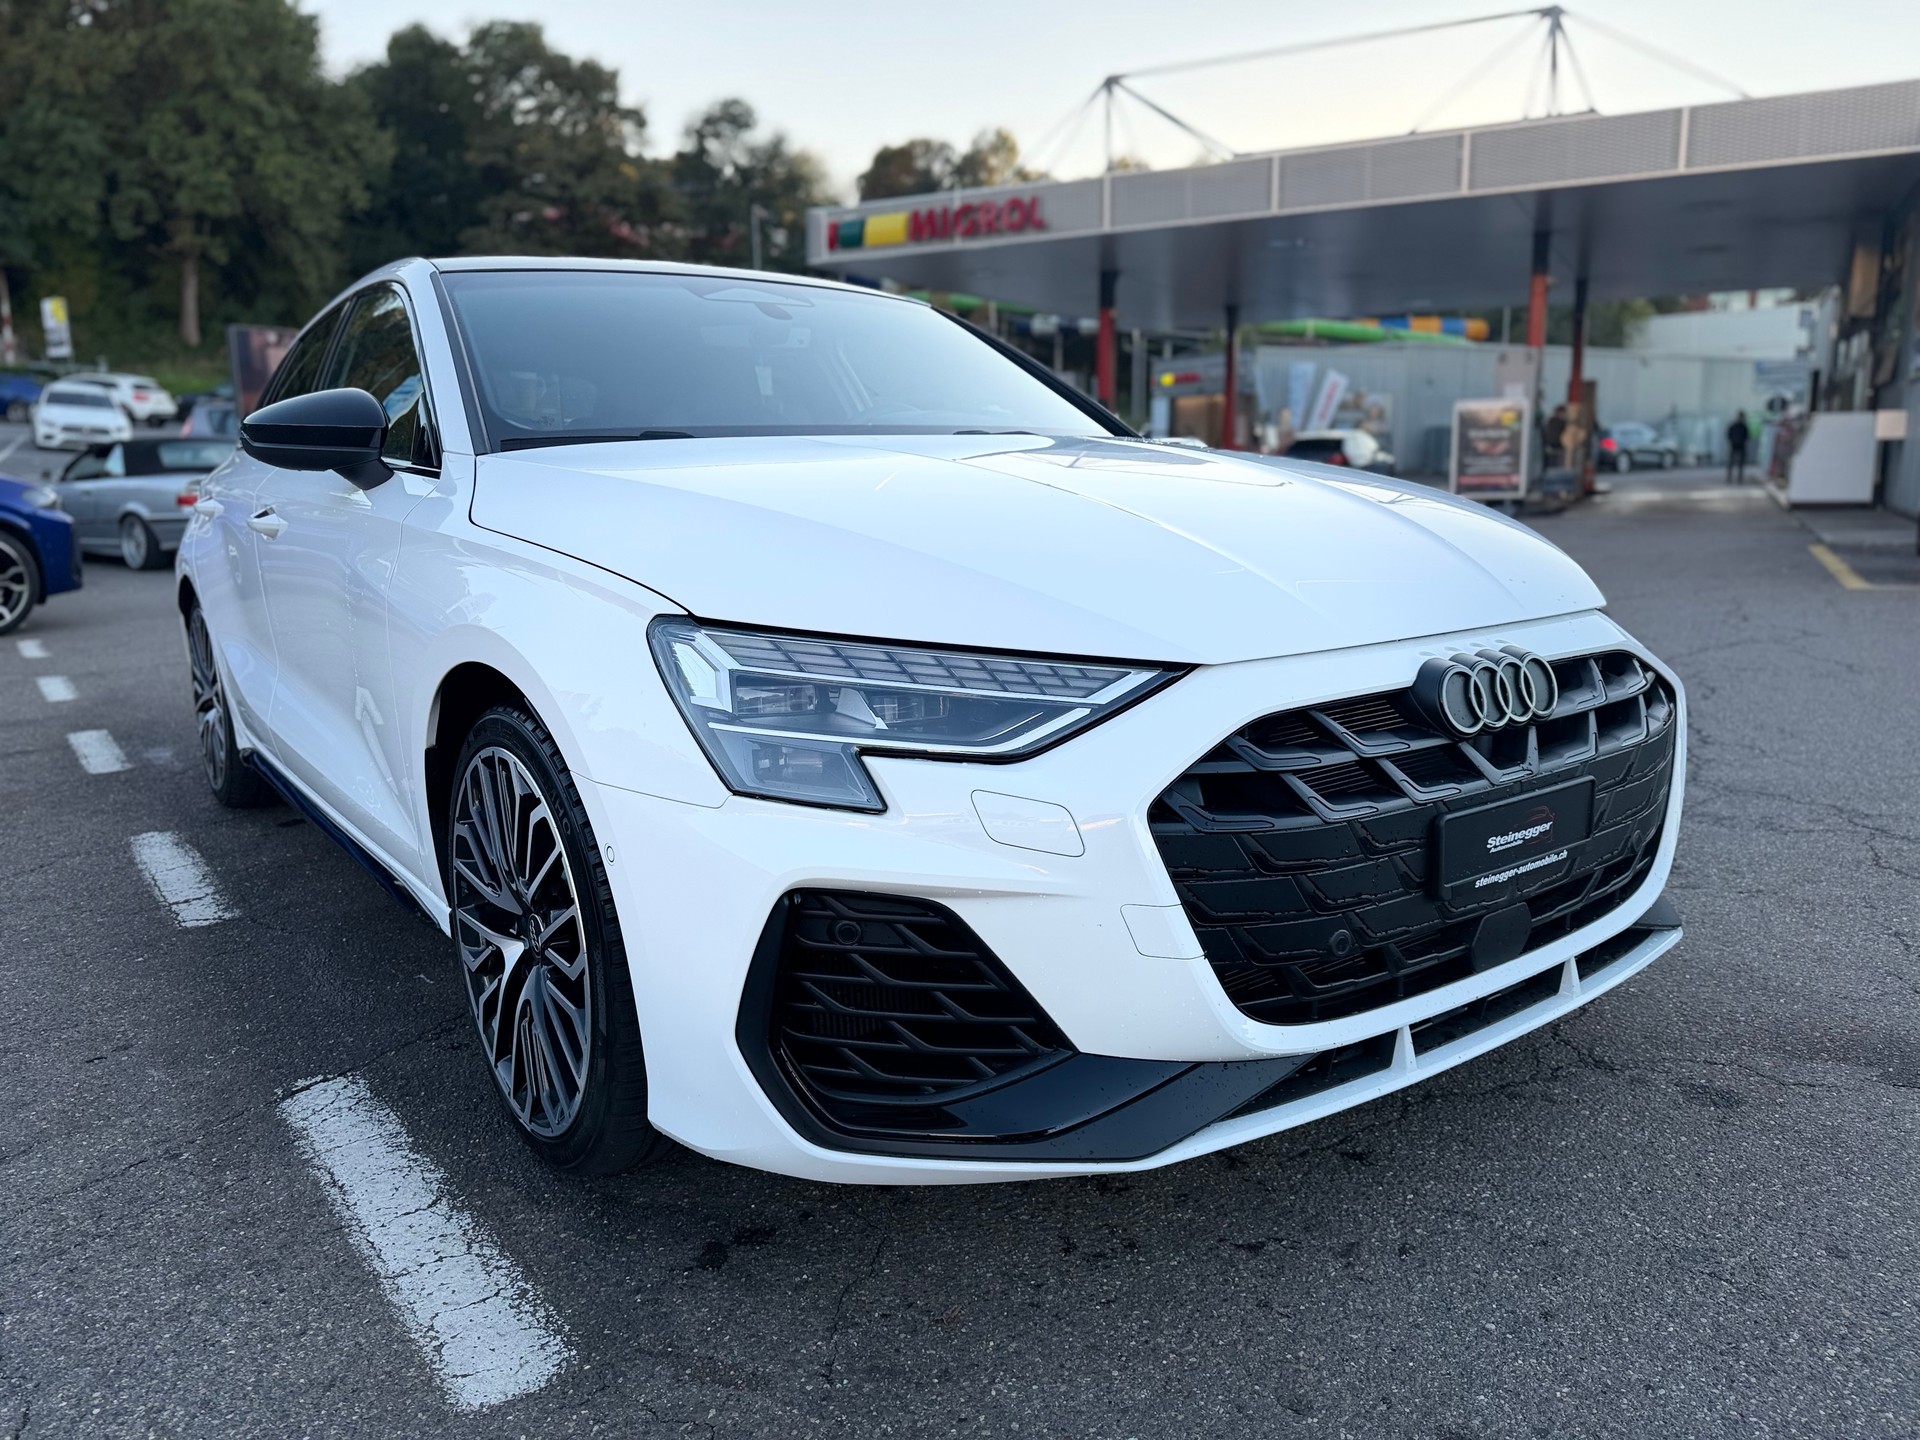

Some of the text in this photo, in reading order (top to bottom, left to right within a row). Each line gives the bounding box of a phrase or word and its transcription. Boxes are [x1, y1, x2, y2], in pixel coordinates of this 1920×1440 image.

[910, 197, 1047, 241] MIGROL
[1486, 821, 1553, 849] Steinegger
[1474, 849, 1568, 888] steinegger-automobile.ch
